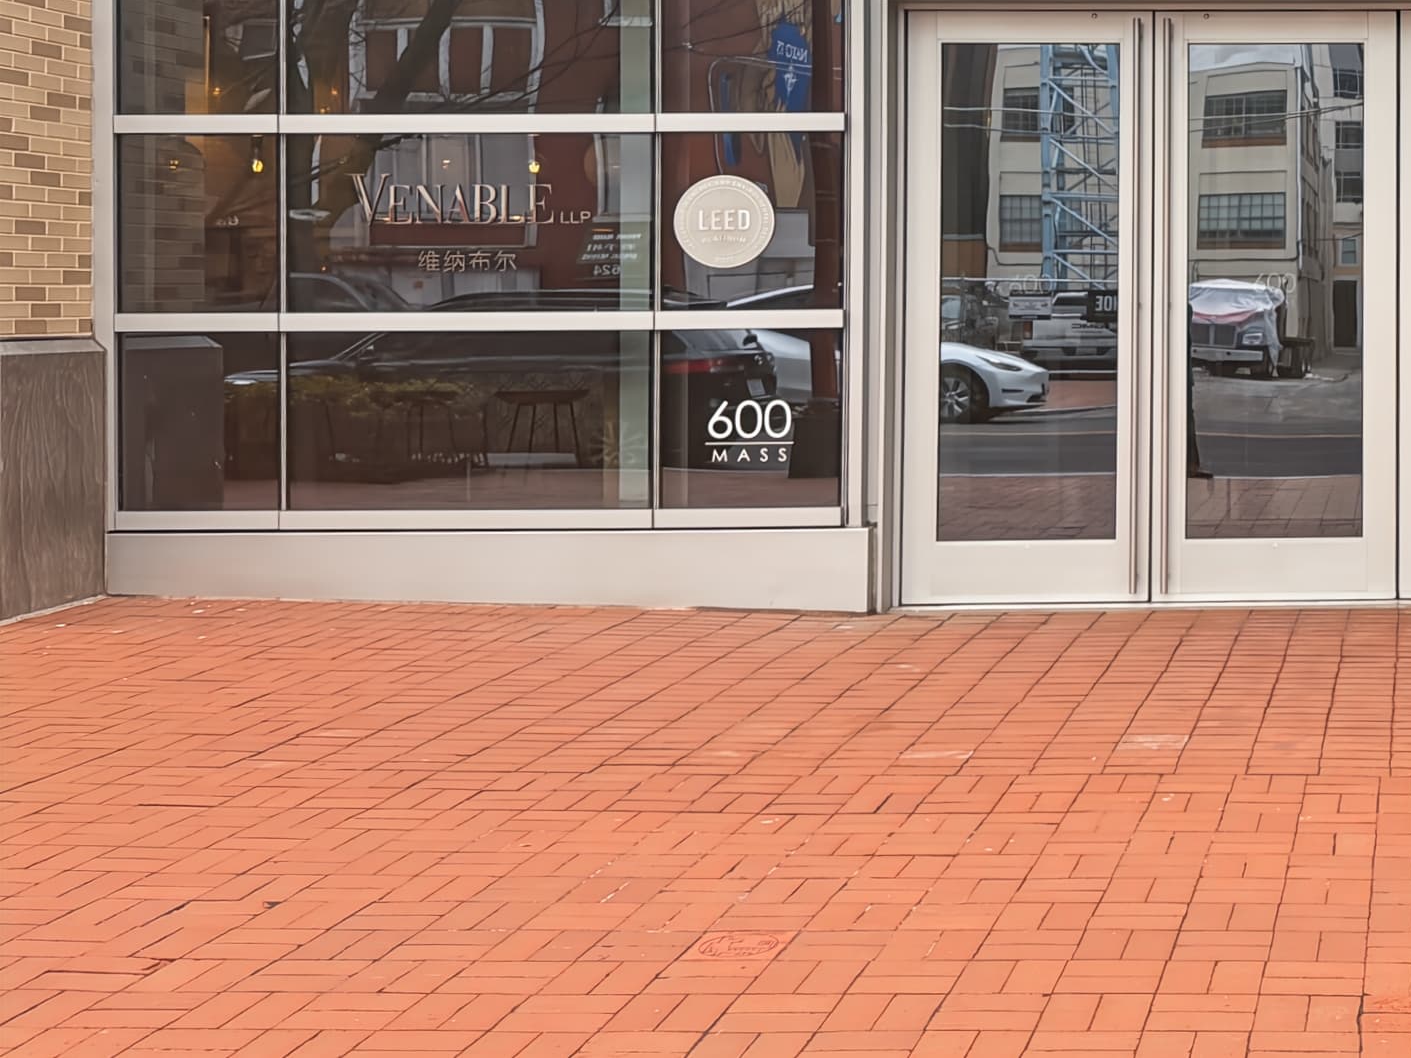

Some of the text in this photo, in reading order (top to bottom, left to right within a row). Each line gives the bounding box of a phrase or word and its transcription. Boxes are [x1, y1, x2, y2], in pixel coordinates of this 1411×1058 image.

[347, 173, 592, 225] VENABLE LLP
[699, 209, 750, 231] LEED
[417, 250, 518, 273] 维纳布尔
[707, 399, 792, 439] 600
[711, 447, 788, 463] MASS
